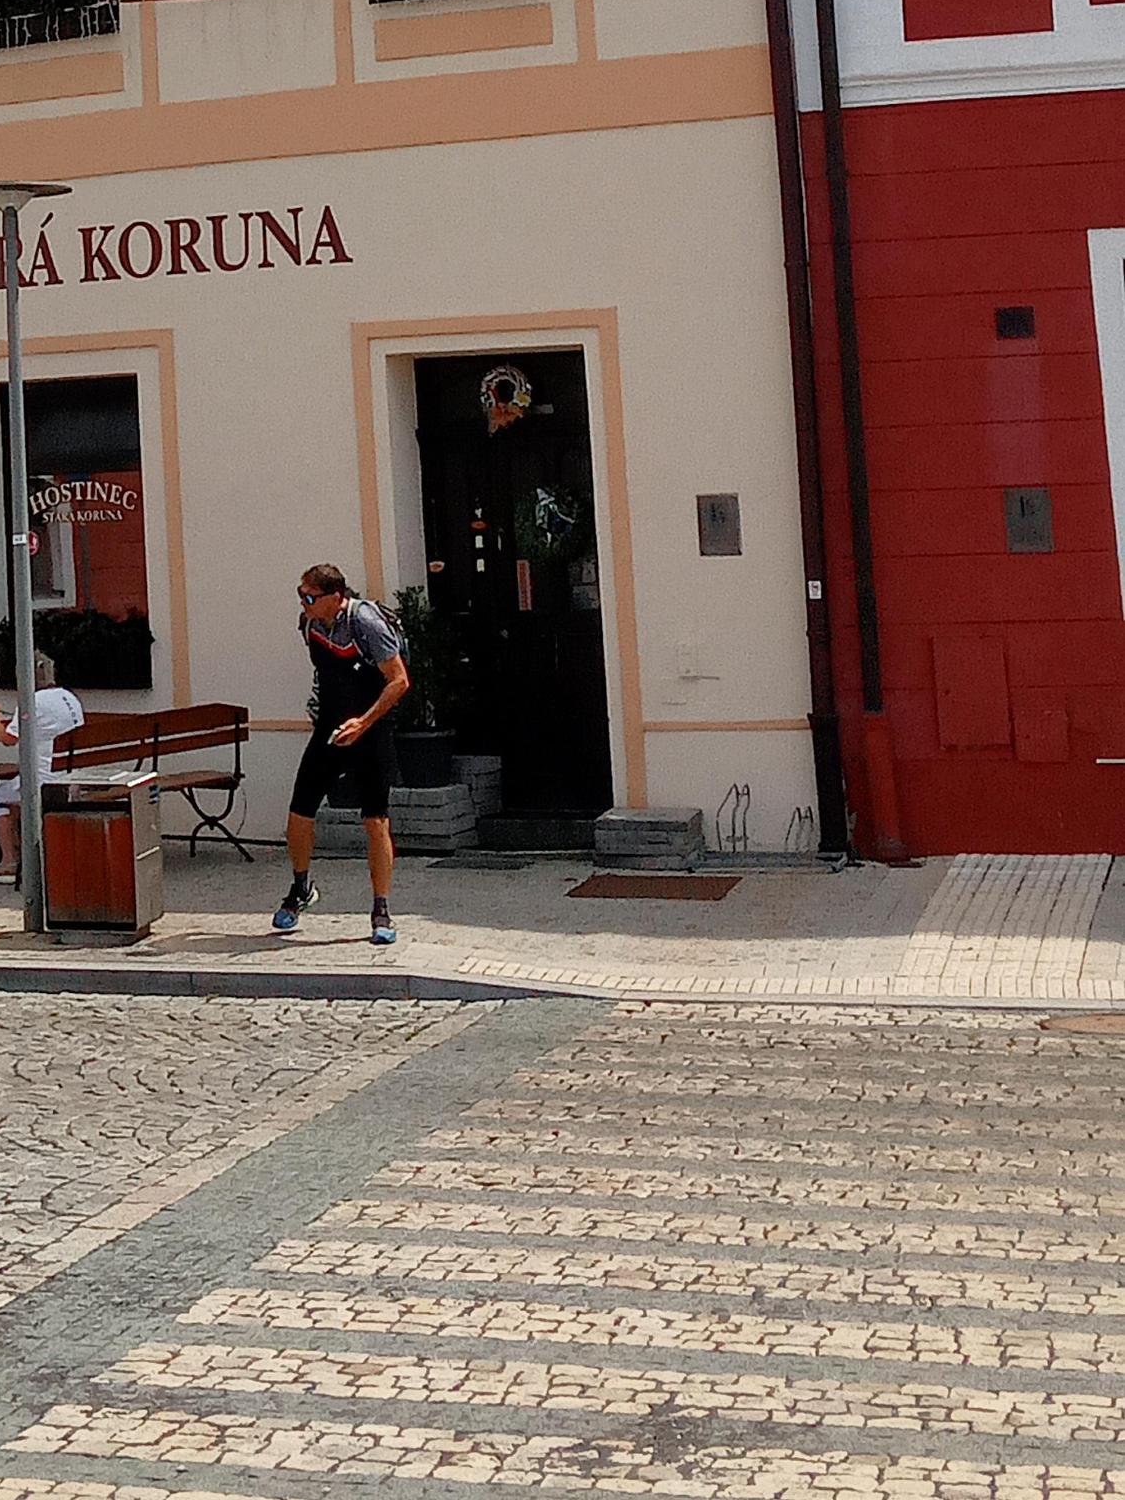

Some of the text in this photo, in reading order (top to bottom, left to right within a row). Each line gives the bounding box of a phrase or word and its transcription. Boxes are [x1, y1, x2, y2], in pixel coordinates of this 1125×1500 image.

[78, 205, 353, 283] KORUNA
[29, 481, 138, 515] HOSTINEC
[77, 509, 123, 522] KORUNA
